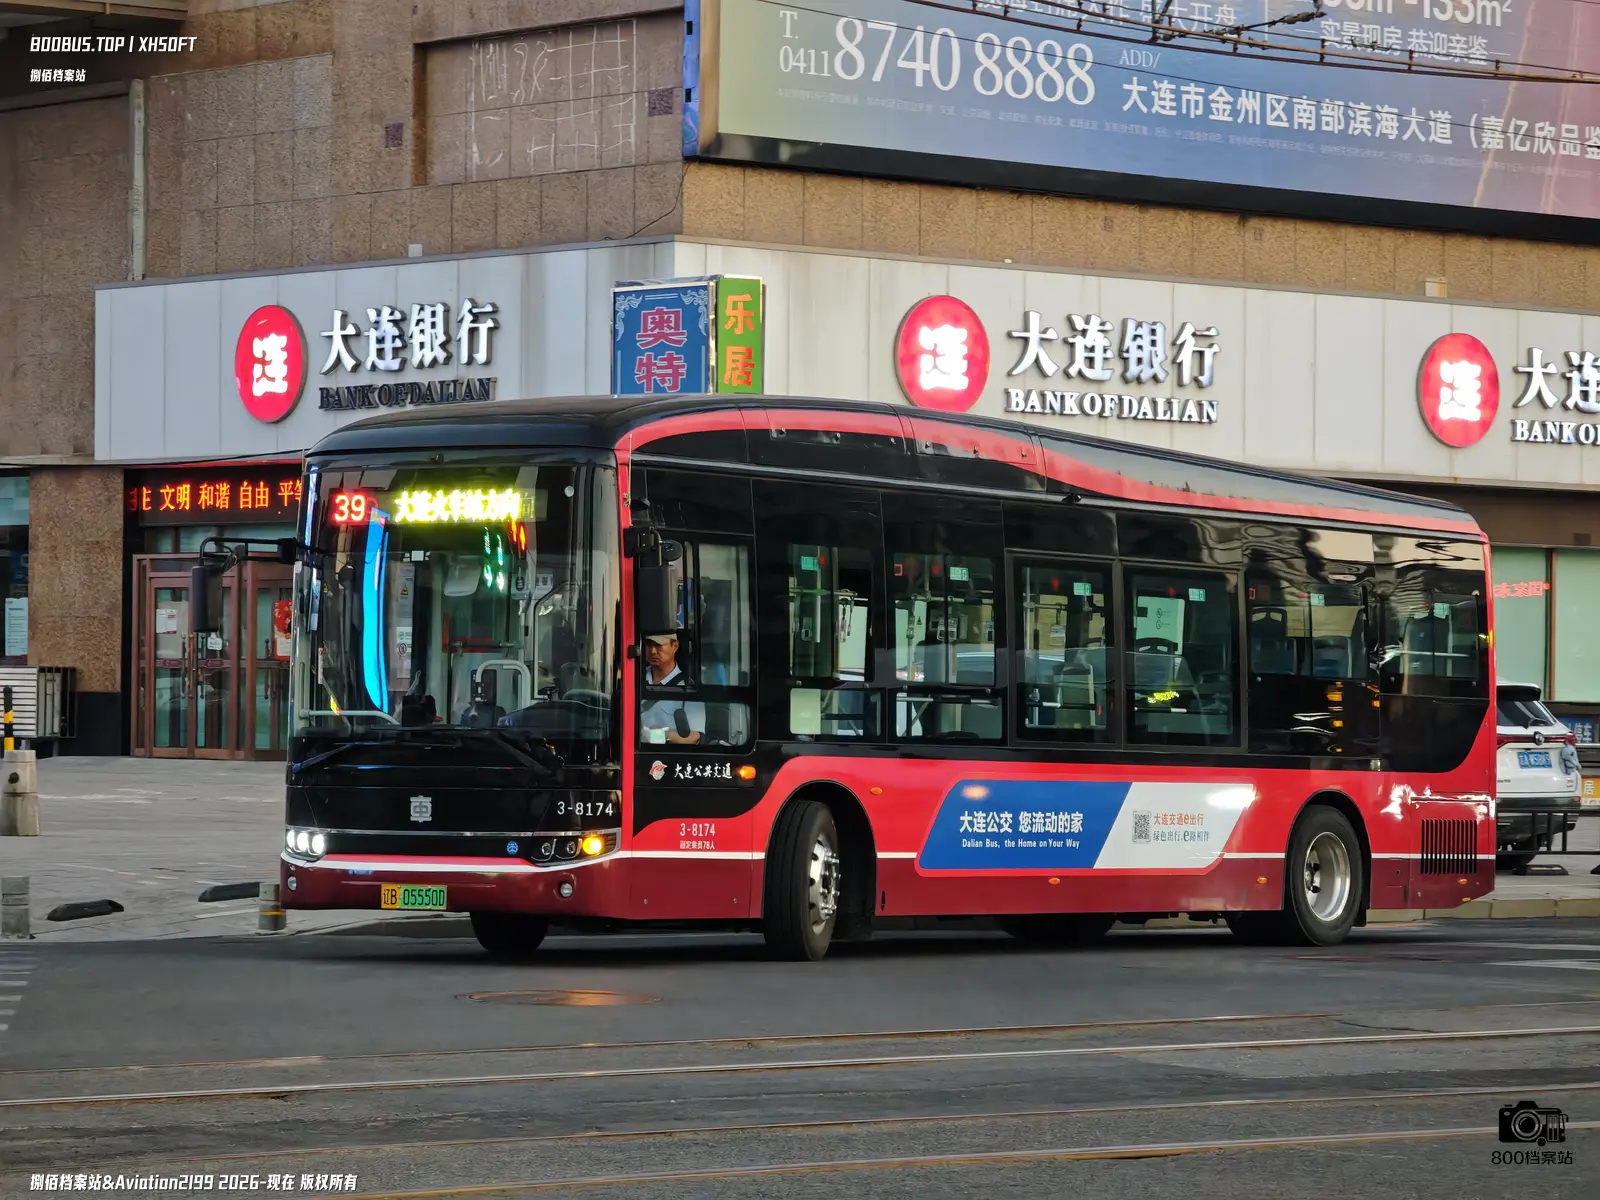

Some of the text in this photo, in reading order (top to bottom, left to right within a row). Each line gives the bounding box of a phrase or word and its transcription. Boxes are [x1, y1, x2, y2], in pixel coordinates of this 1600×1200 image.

[779, 10, 799, 39] T.
[779, 16, 1096, 106] 0411 8740 8888
[1119, 48, 1162, 69] ADD/
[318, 298, 500, 376] 大连银行
[635, 306, 688, 393] 奥特
[723, 293, 756, 388] 乐居
[1006, 309, 1222, 388] 大连银行
[1512, 346, 1600, 415] 大连
[159, 483, 191, 511] 文明
[197, 481, 230, 510] 和谐
[239, 479, 269, 509] 自由
[333, 493, 366, 522] 39
[556, 801, 615, 817] 3-8174
[959, 811, 1084, 834] 大连公交 您流动的家
[679, 823, 716, 837] 3-8174
[962, 838, 983, 848] Dalian
[1004, 838, 1016, 848] the
[1017, 838, 1037, 848] Home
[1039, 840, 1048, 848] on
[1048, 838, 1064, 848] Your
[1066, 838, 1080, 849] Way
[402, 888, 446, 907] 05550D
